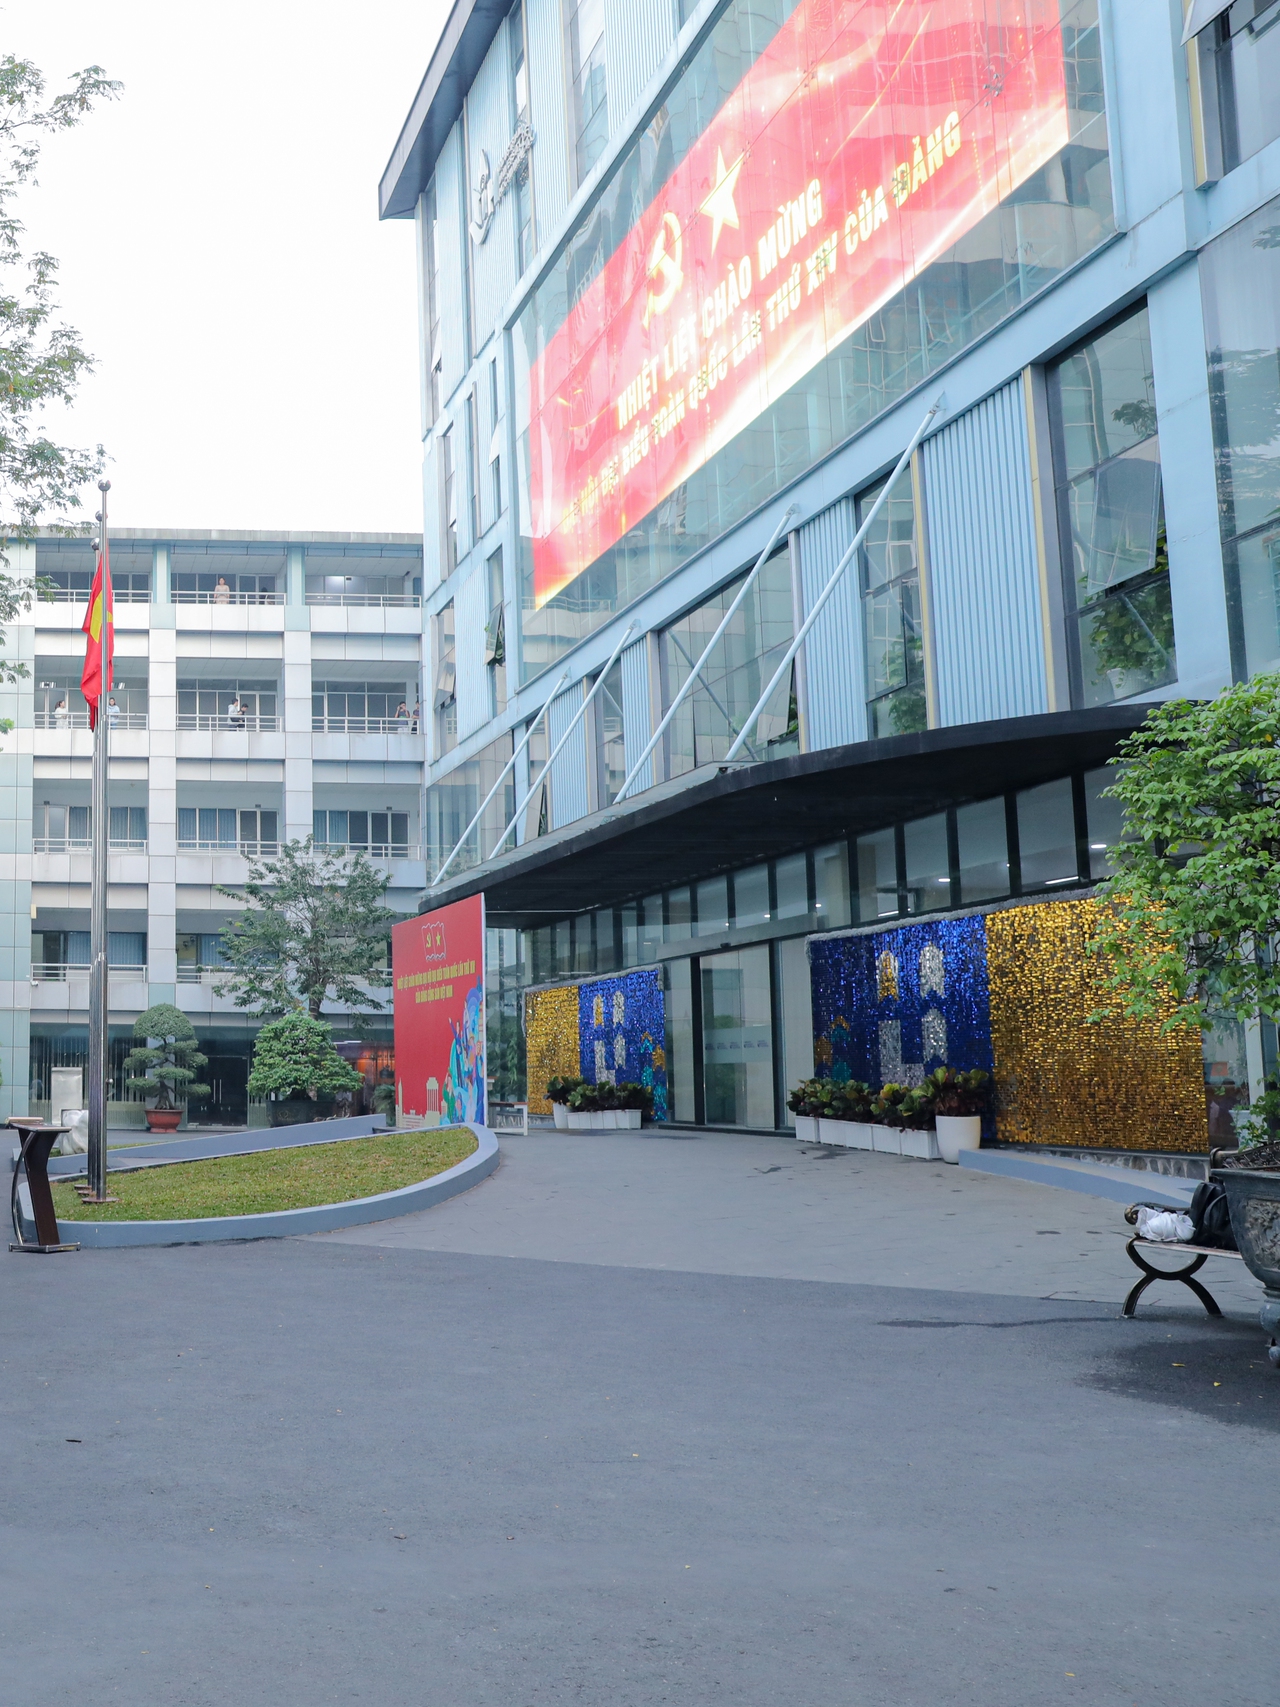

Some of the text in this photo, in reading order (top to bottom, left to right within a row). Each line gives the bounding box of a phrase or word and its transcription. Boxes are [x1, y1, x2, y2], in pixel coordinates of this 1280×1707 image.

[618, 178, 822, 430] NHIỆT LIỆT CHÀO MỪNG
[622, 420, 649, 476] BIỂU
[651, 388, 685, 445] TOÀN
[689, 341, 728, 411] QUỐC
[732, 309, 762, 368] LẦN
[766, 262, 801, 332] THỨ
[844, 185, 888, 255] CỦA
[894, 111, 961, 208] ĐẢNG
